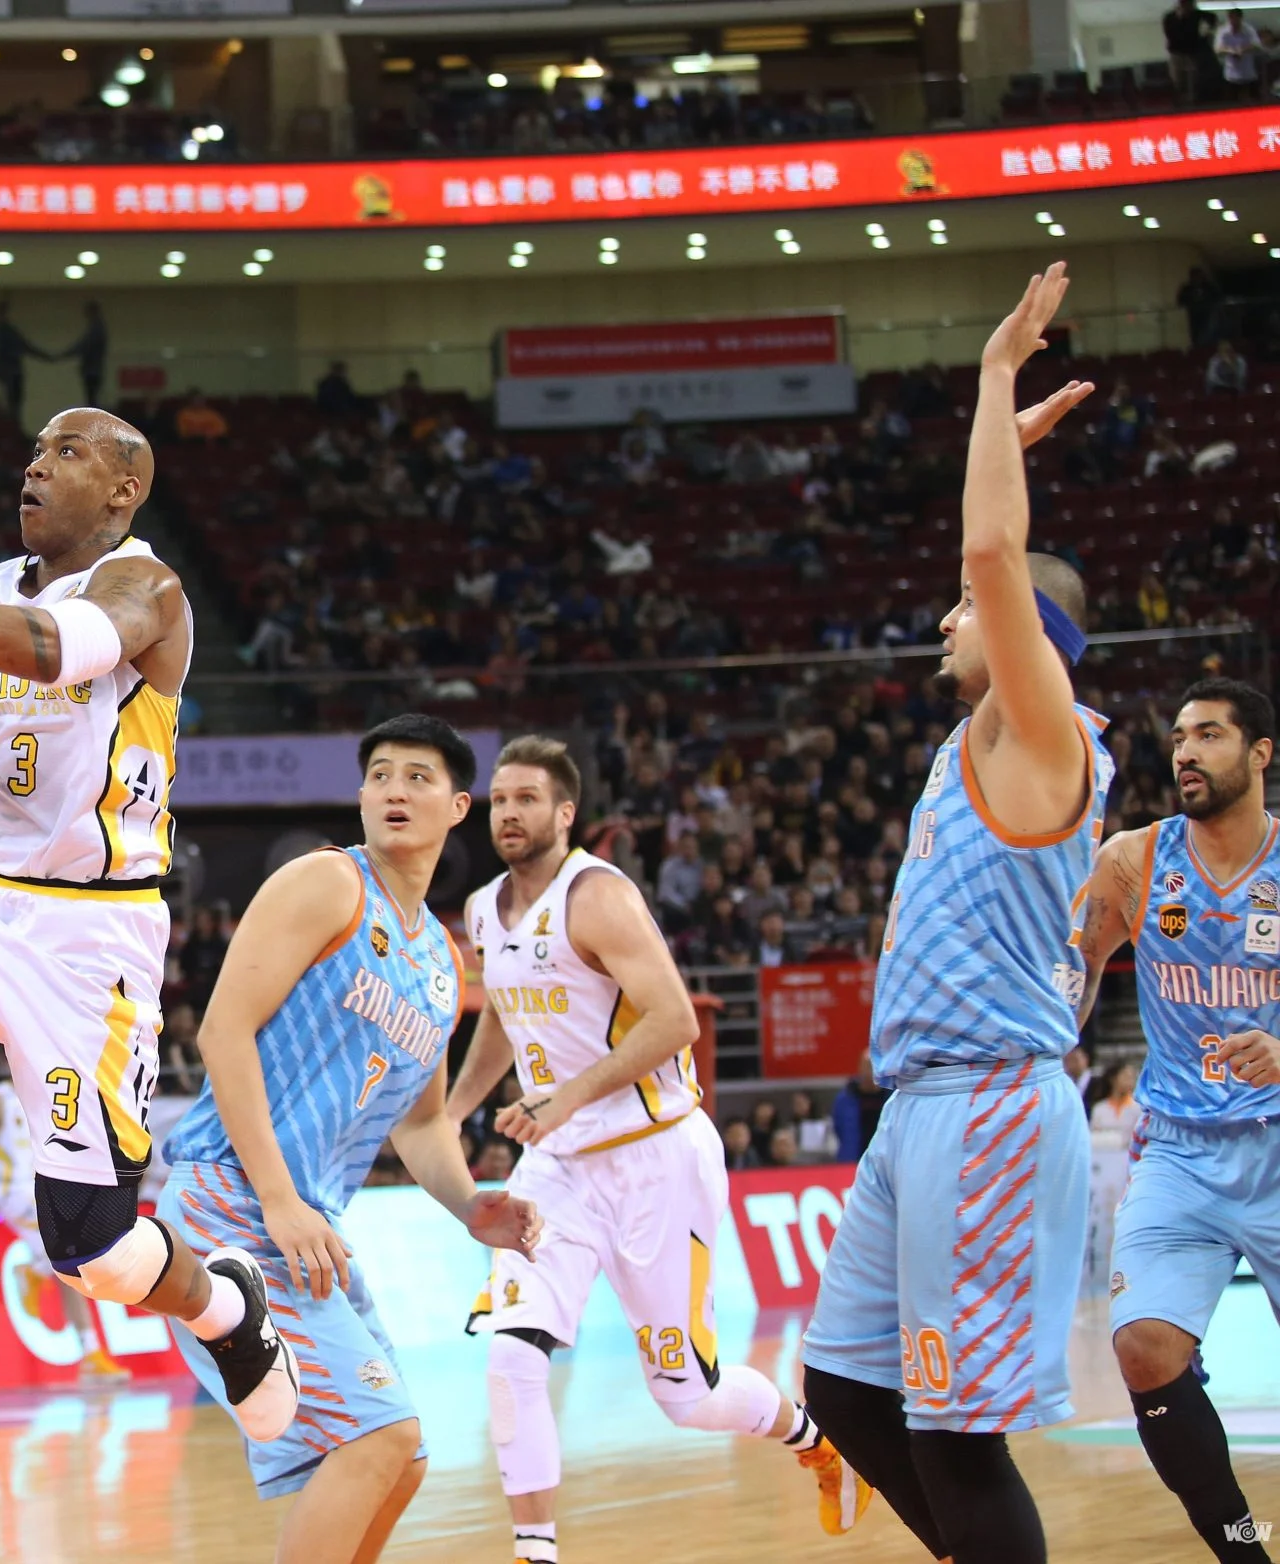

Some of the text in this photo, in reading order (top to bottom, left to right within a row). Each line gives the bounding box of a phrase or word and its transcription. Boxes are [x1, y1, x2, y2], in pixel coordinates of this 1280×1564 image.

[7, 733, 38, 797] 3
[1161, 915, 1185, 934] ups
[343, 967, 444, 1067] XINJIANG
[46, 1067, 81, 1131] 3
[356, 1052, 390, 1110] 7
[744, 1185, 851, 1289] TC
[901, 1324, 952, 1392] 20
